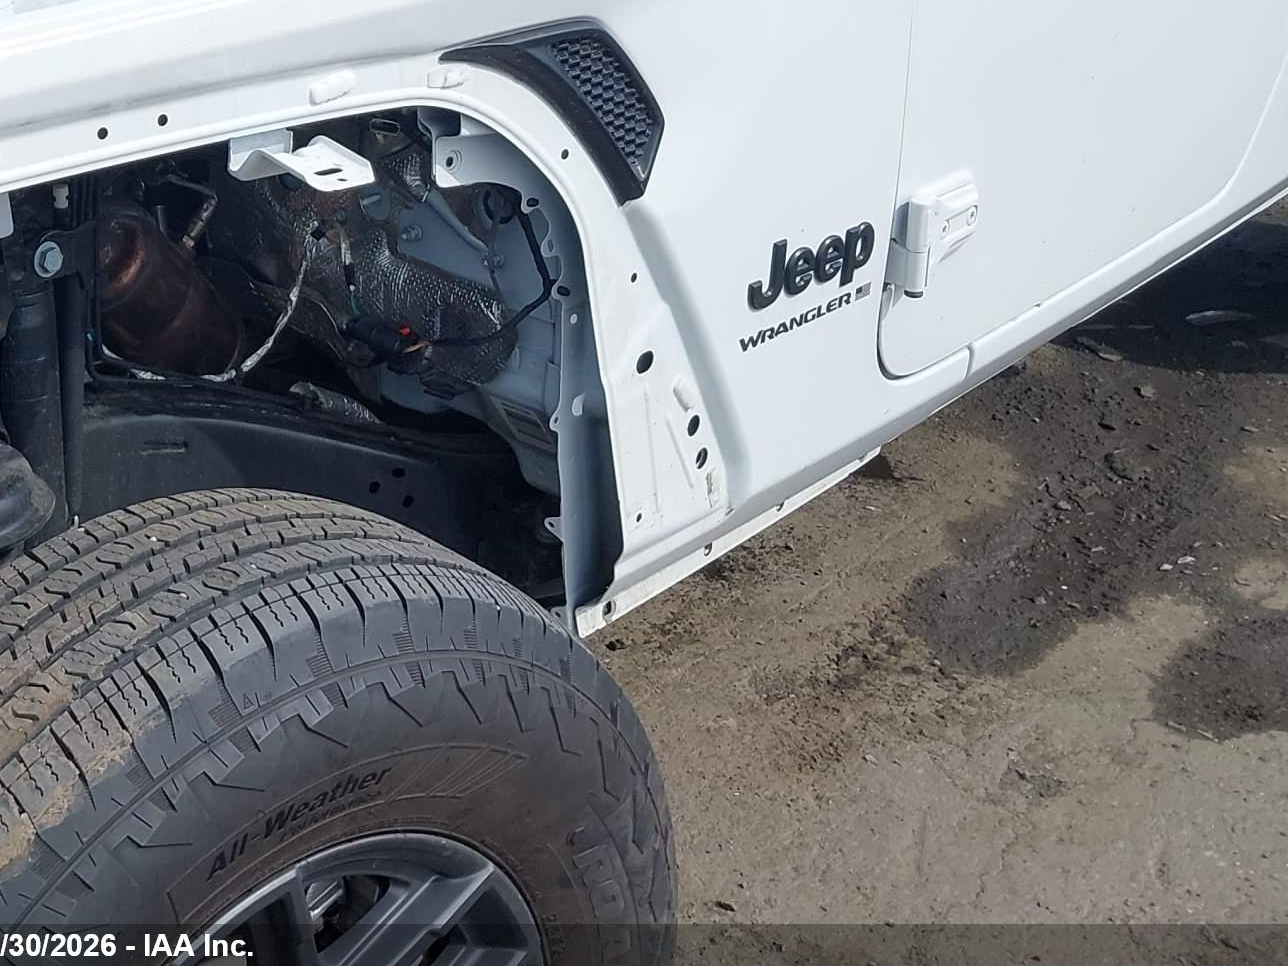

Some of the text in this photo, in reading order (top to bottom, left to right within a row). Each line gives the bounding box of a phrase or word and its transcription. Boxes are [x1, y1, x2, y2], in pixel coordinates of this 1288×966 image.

[747, 221, 876, 311] Jeep
[739, 292, 852, 353] WRANGLER
[207, 767, 392, 882] All-Weather
